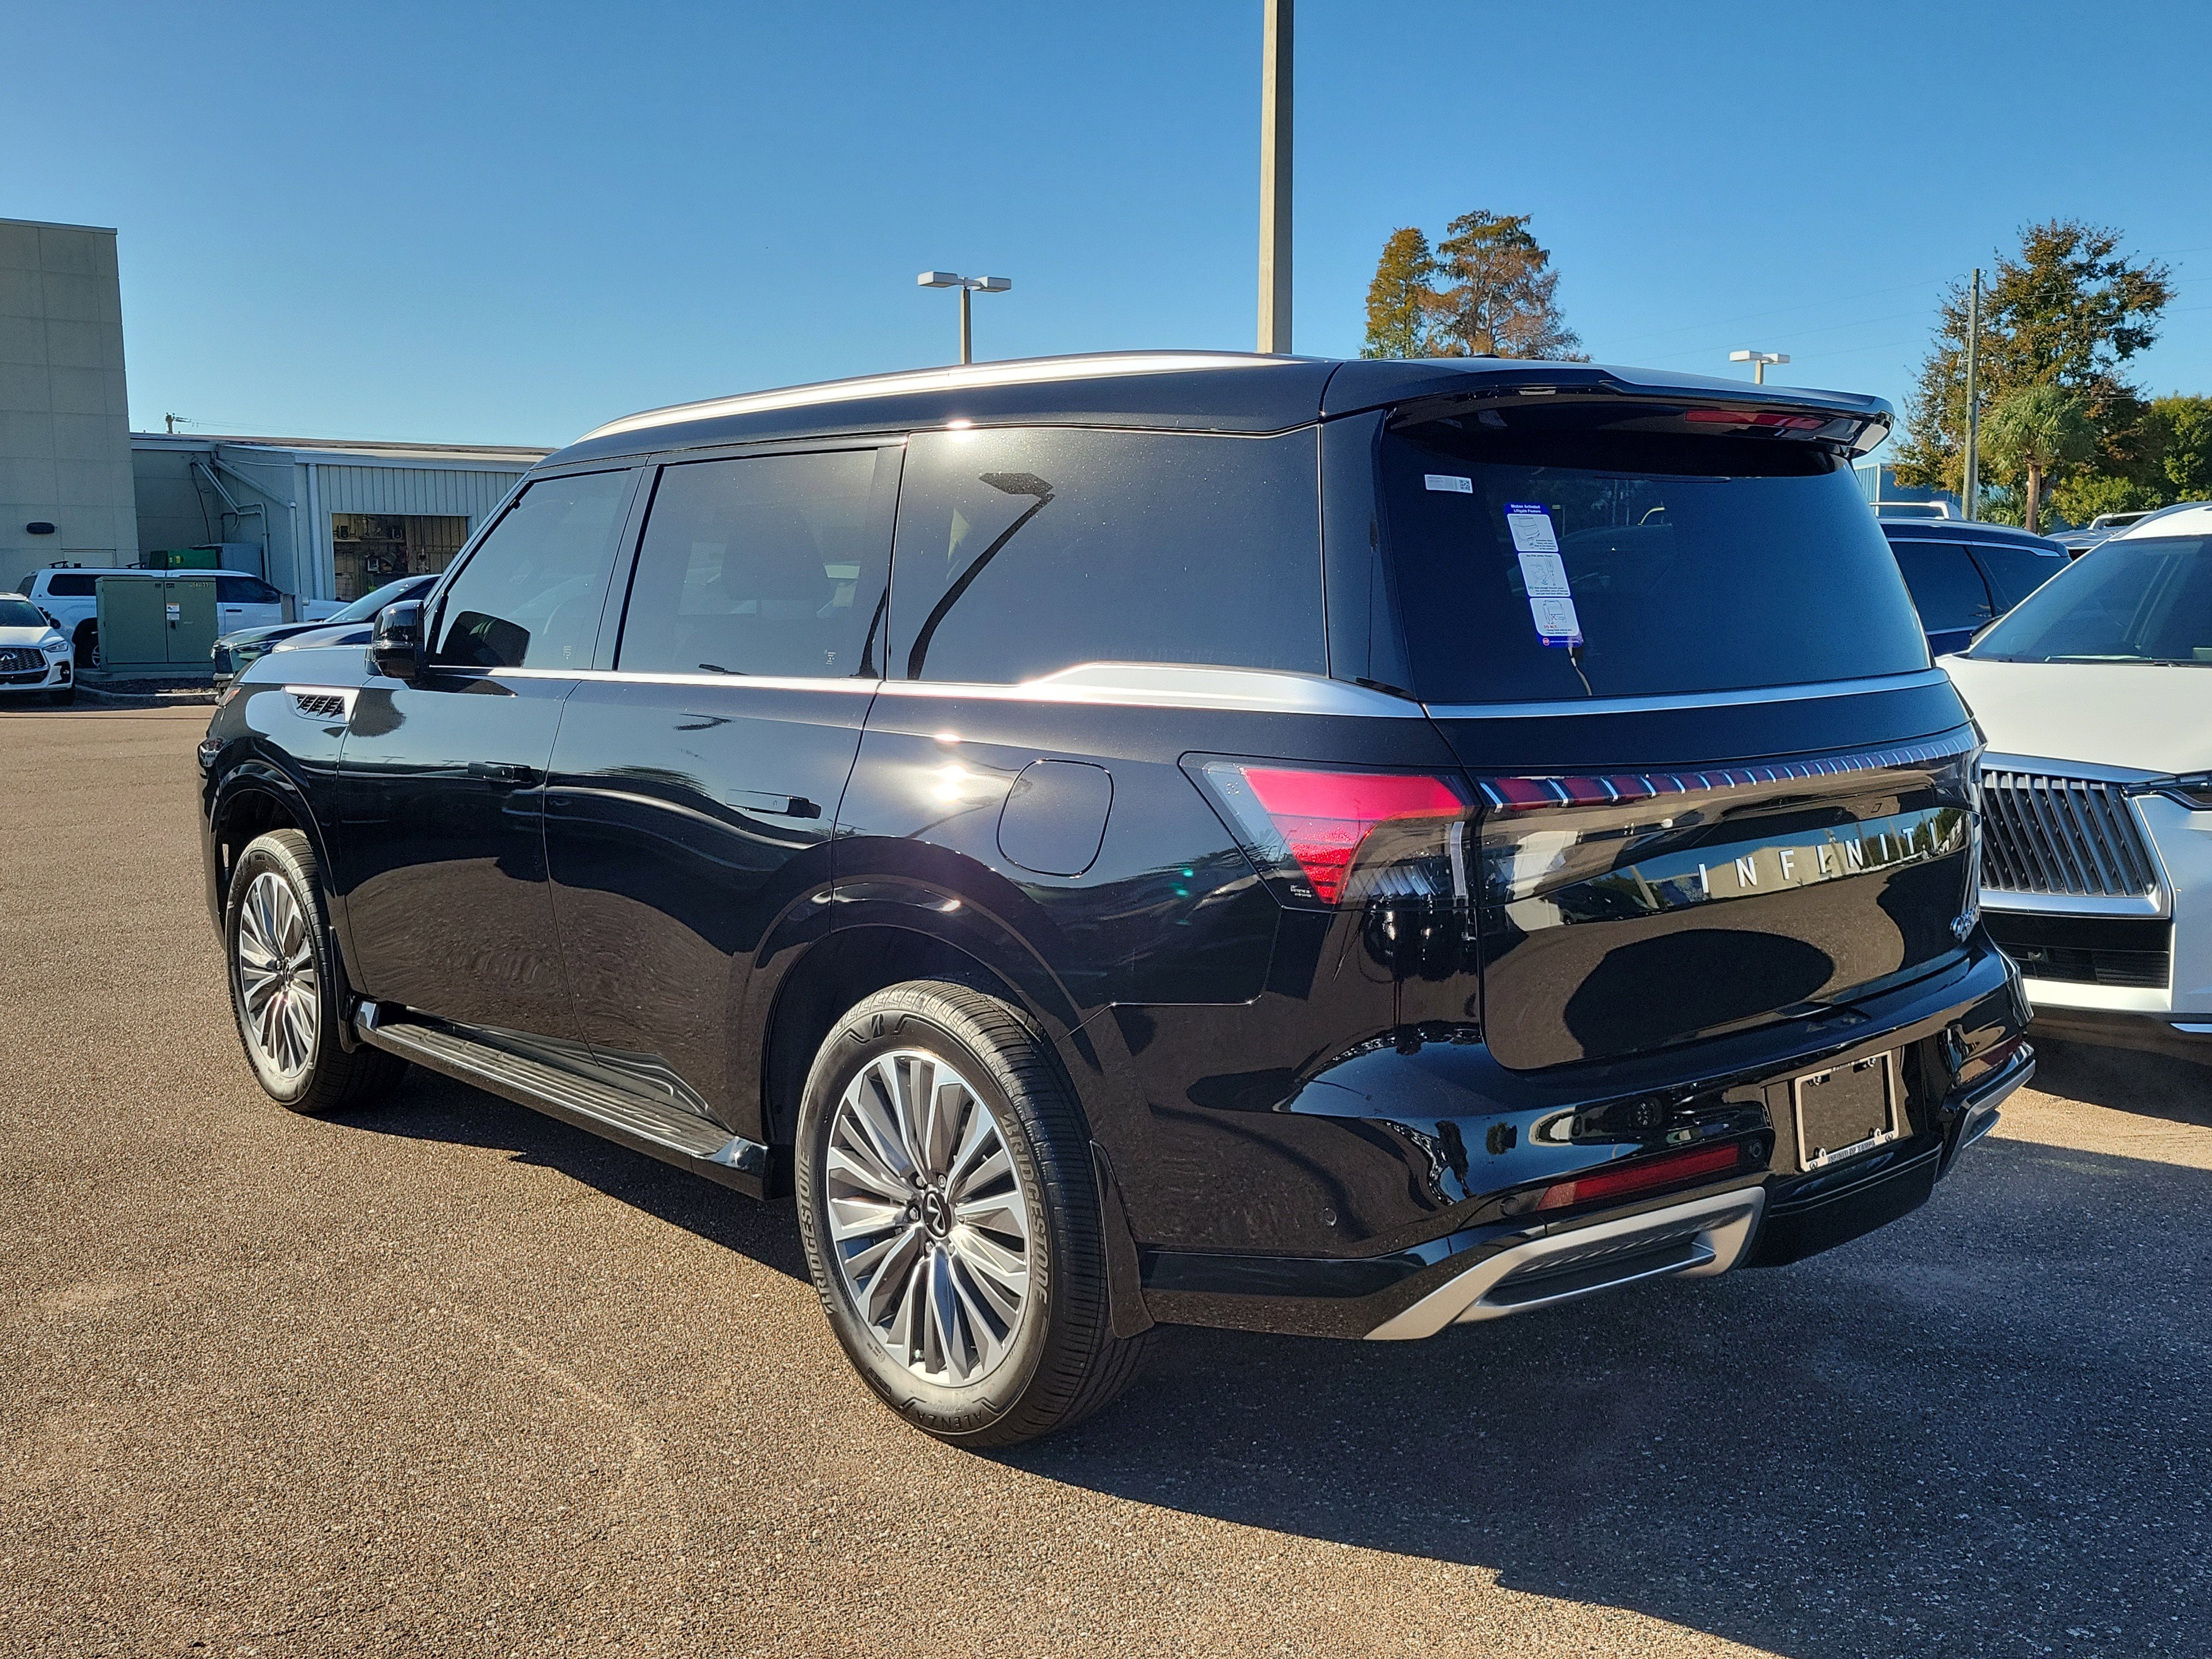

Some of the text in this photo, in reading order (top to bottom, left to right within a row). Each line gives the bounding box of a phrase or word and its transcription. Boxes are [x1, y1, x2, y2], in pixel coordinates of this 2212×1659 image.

[1697, 821, 1938, 895] INFINITI
[799, 1150, 838, 1314] BRIDGESTONE
[1000, 1113, 1049, 1305] BRIDGESTONE
[916, 1409, 982, 1430] ALENZA
